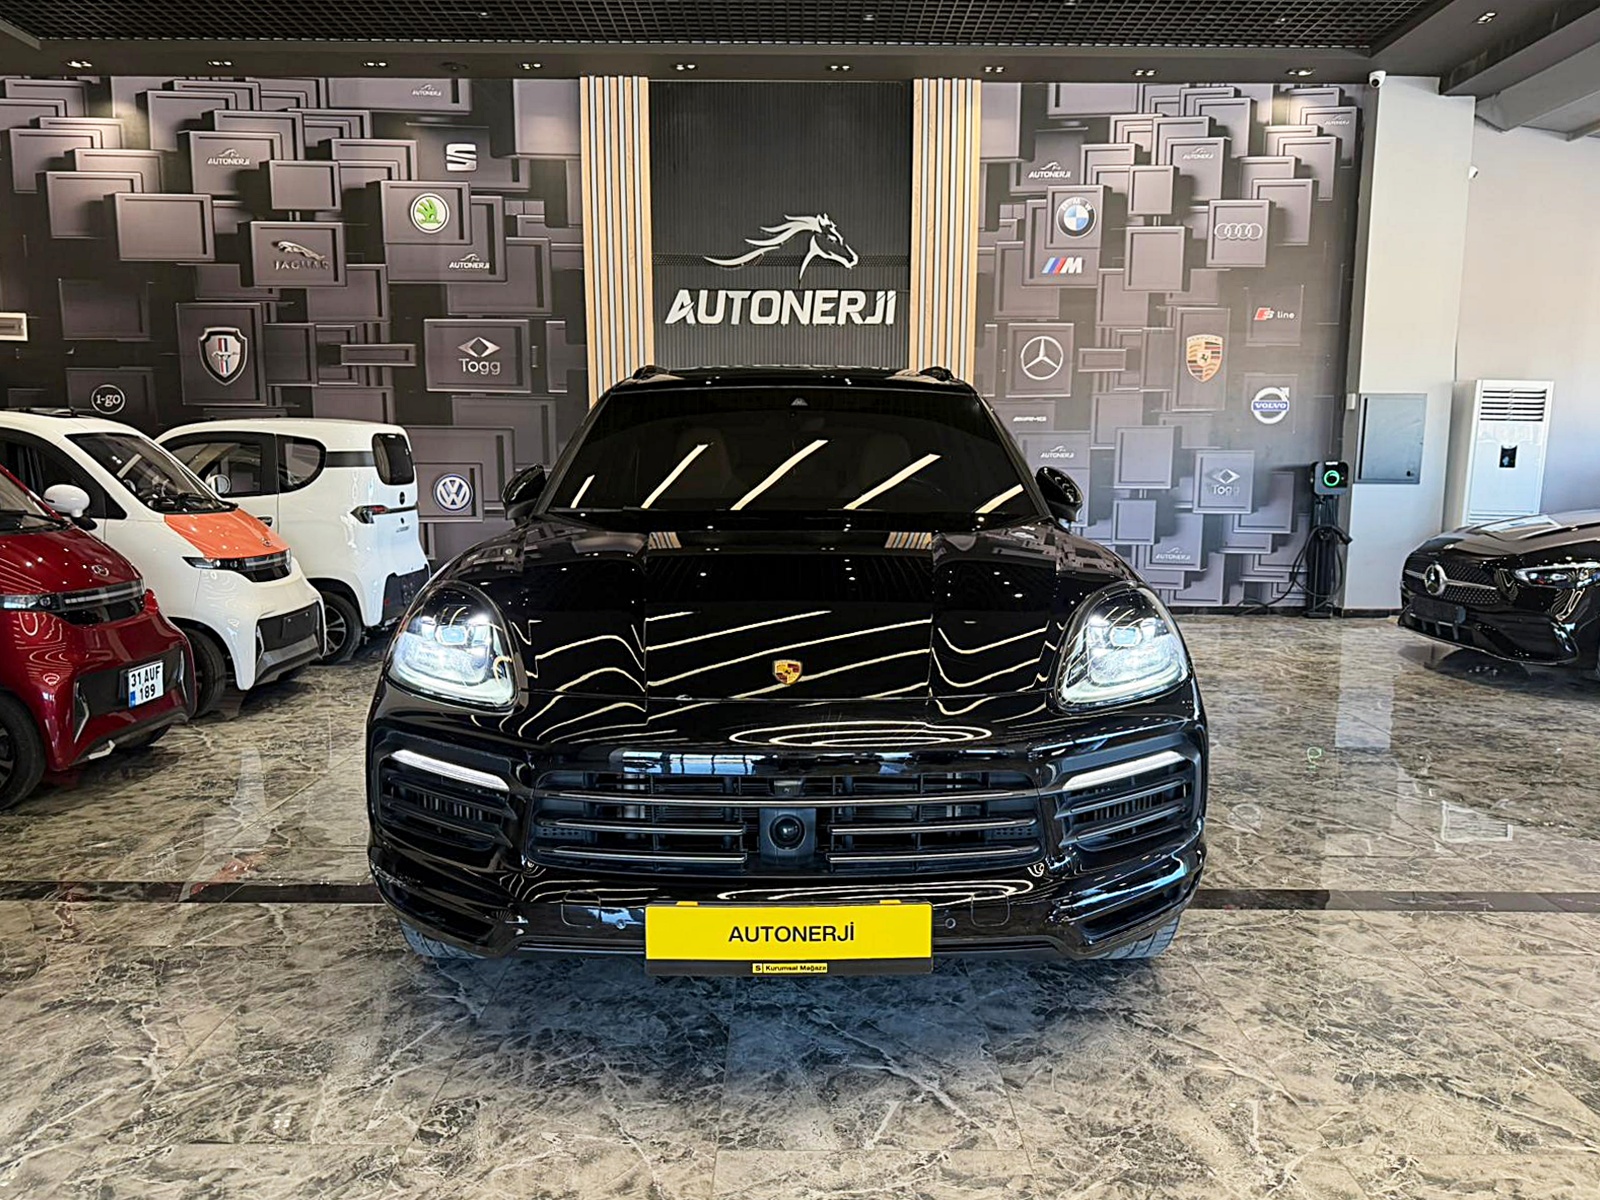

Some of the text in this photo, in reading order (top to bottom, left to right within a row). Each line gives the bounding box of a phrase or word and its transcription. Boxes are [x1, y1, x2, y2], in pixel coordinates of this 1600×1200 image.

[274, 260, 330, 270] JAGUAR
[1276, 310, 1296, 319] line
[458, 358, 501, 376] Togg
[1254, 401, 1288, 410] VOLVO
[131, 665, 161, 687] 31 AUF
[139, 684, 156, 700] 189
[728, 921, 855, 943] AUTONERJİ
[800, 964, 827, 972] Mağaza
